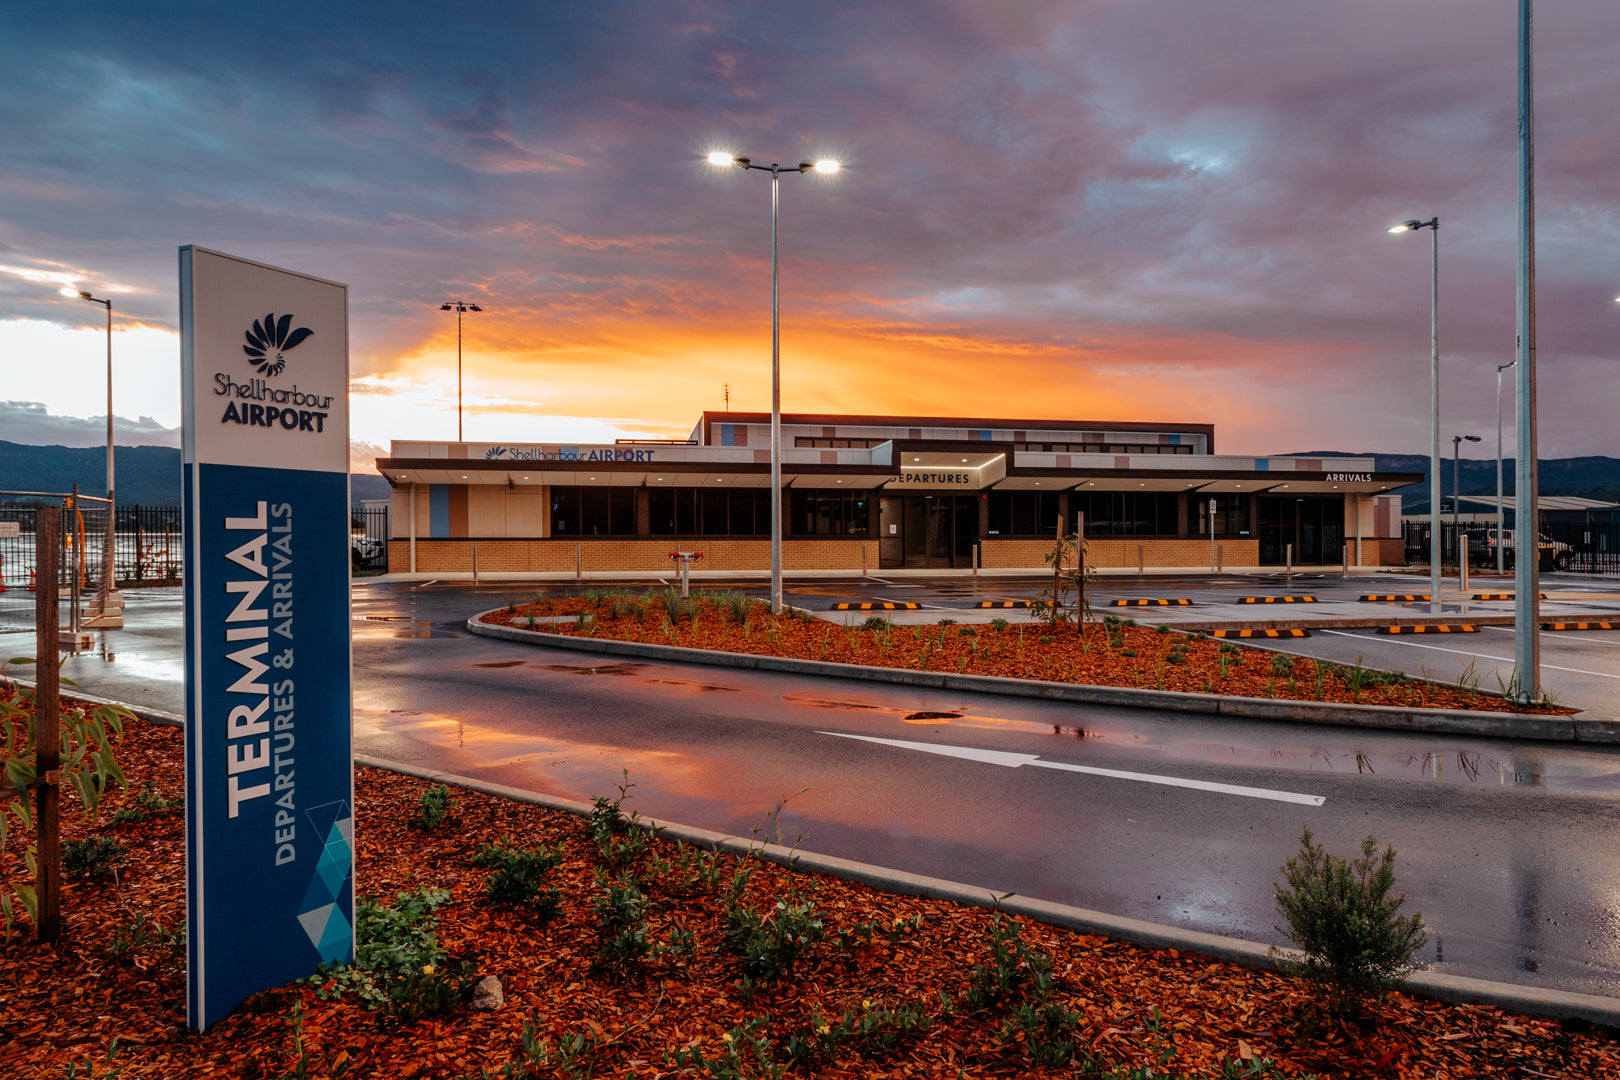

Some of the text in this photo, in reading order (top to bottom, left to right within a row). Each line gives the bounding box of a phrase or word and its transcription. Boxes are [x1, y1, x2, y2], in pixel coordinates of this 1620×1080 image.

[214, 372, 335, 409] Shellharbour
[221, 401, 328, 432] AIRPORT
[508, 447, 655, 462] Shellharbour AIRPORT
[1326, 473, 1372, 482] ARRIVALS
[224, 500, 271, 819] TERMINAL
[271, 502, 296, 867] DEPARTURES & ARRIVALS
